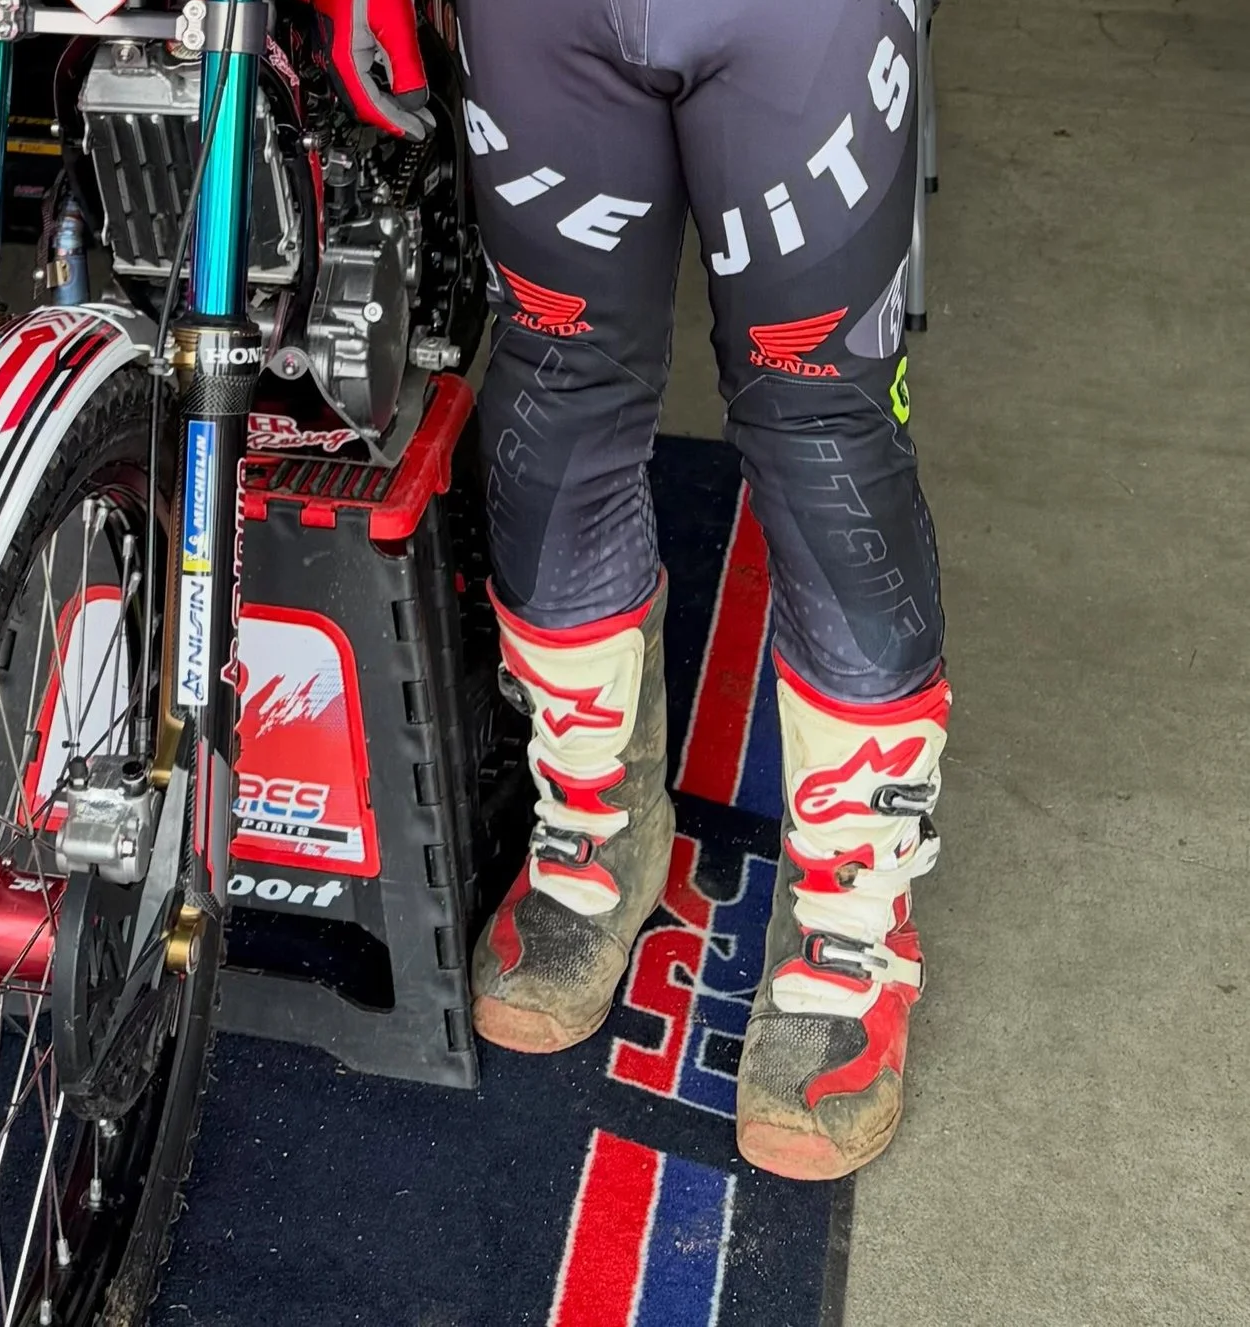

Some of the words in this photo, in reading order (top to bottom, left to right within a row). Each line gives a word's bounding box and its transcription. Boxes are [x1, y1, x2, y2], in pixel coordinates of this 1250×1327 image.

[511, 310, 595, 337] HONDA
[205, 346, 266, 365] HON
[749, 349, 841, 377] HONDA
[193, 434, 208, 528] MICHELIN
